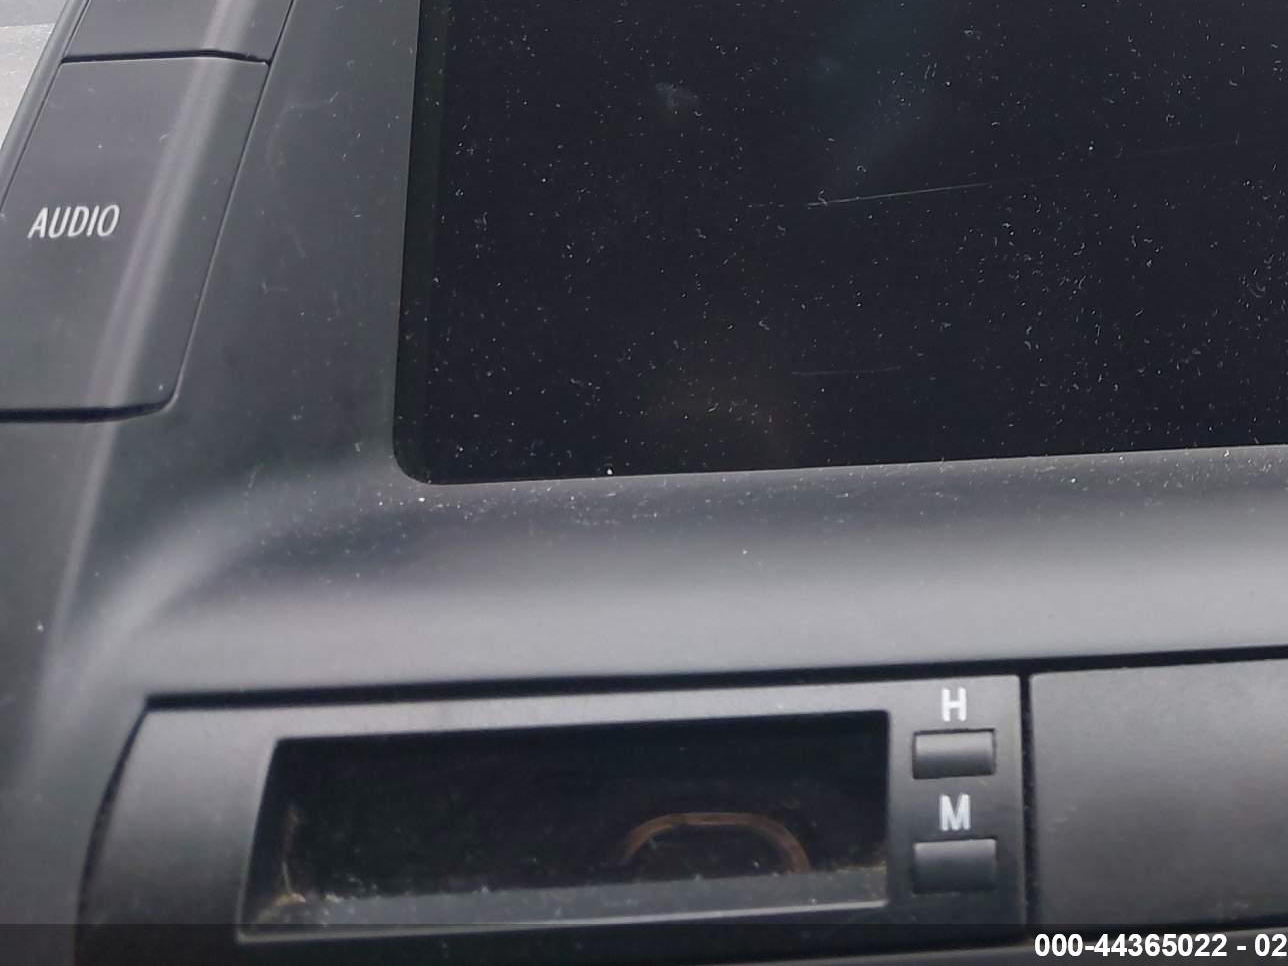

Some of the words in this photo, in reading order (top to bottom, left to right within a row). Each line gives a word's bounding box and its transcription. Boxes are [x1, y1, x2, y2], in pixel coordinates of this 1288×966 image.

[27, 204, 120, 239] AUDIO
[941, 687, 967, 722] H
[941, 794, 970, 831] M
